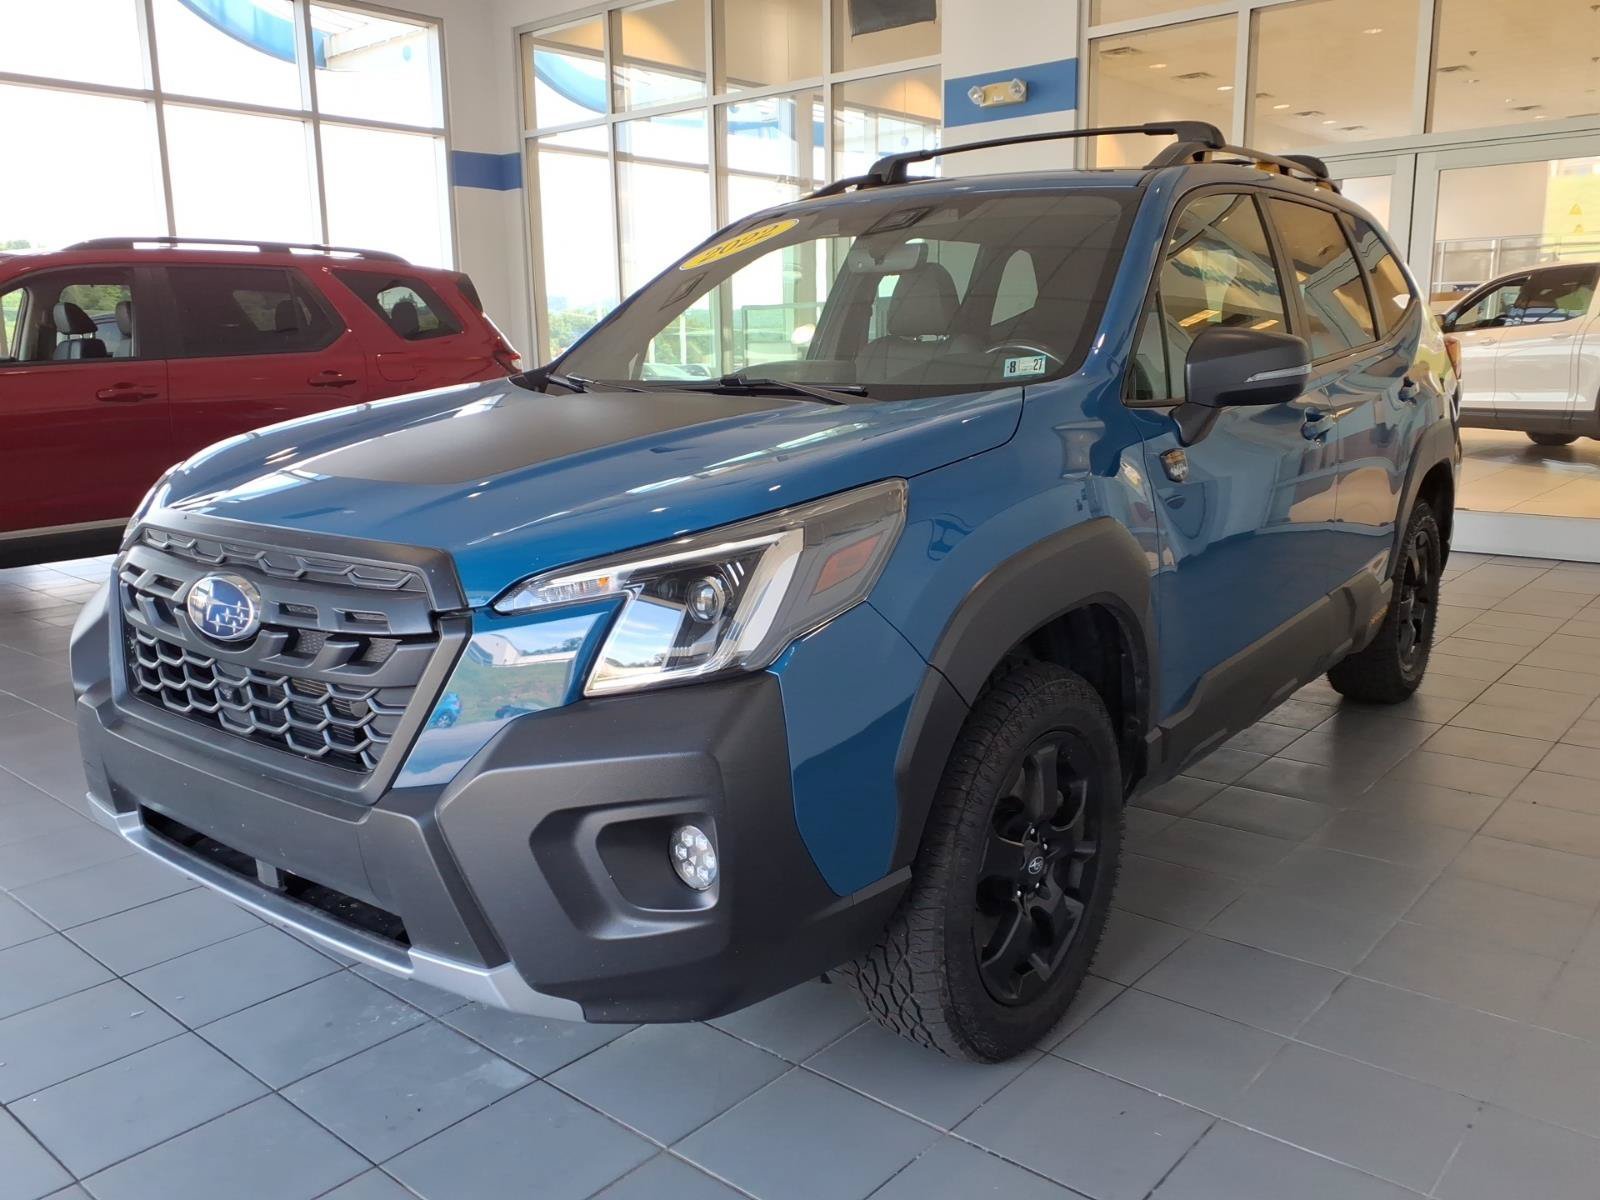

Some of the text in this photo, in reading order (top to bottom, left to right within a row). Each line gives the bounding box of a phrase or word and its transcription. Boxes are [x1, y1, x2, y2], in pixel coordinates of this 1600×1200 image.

[699, 224, 779, 262] 2022
[1009, 361, 1017, 373] 8
[1033, 358, 1043, 371] 27
